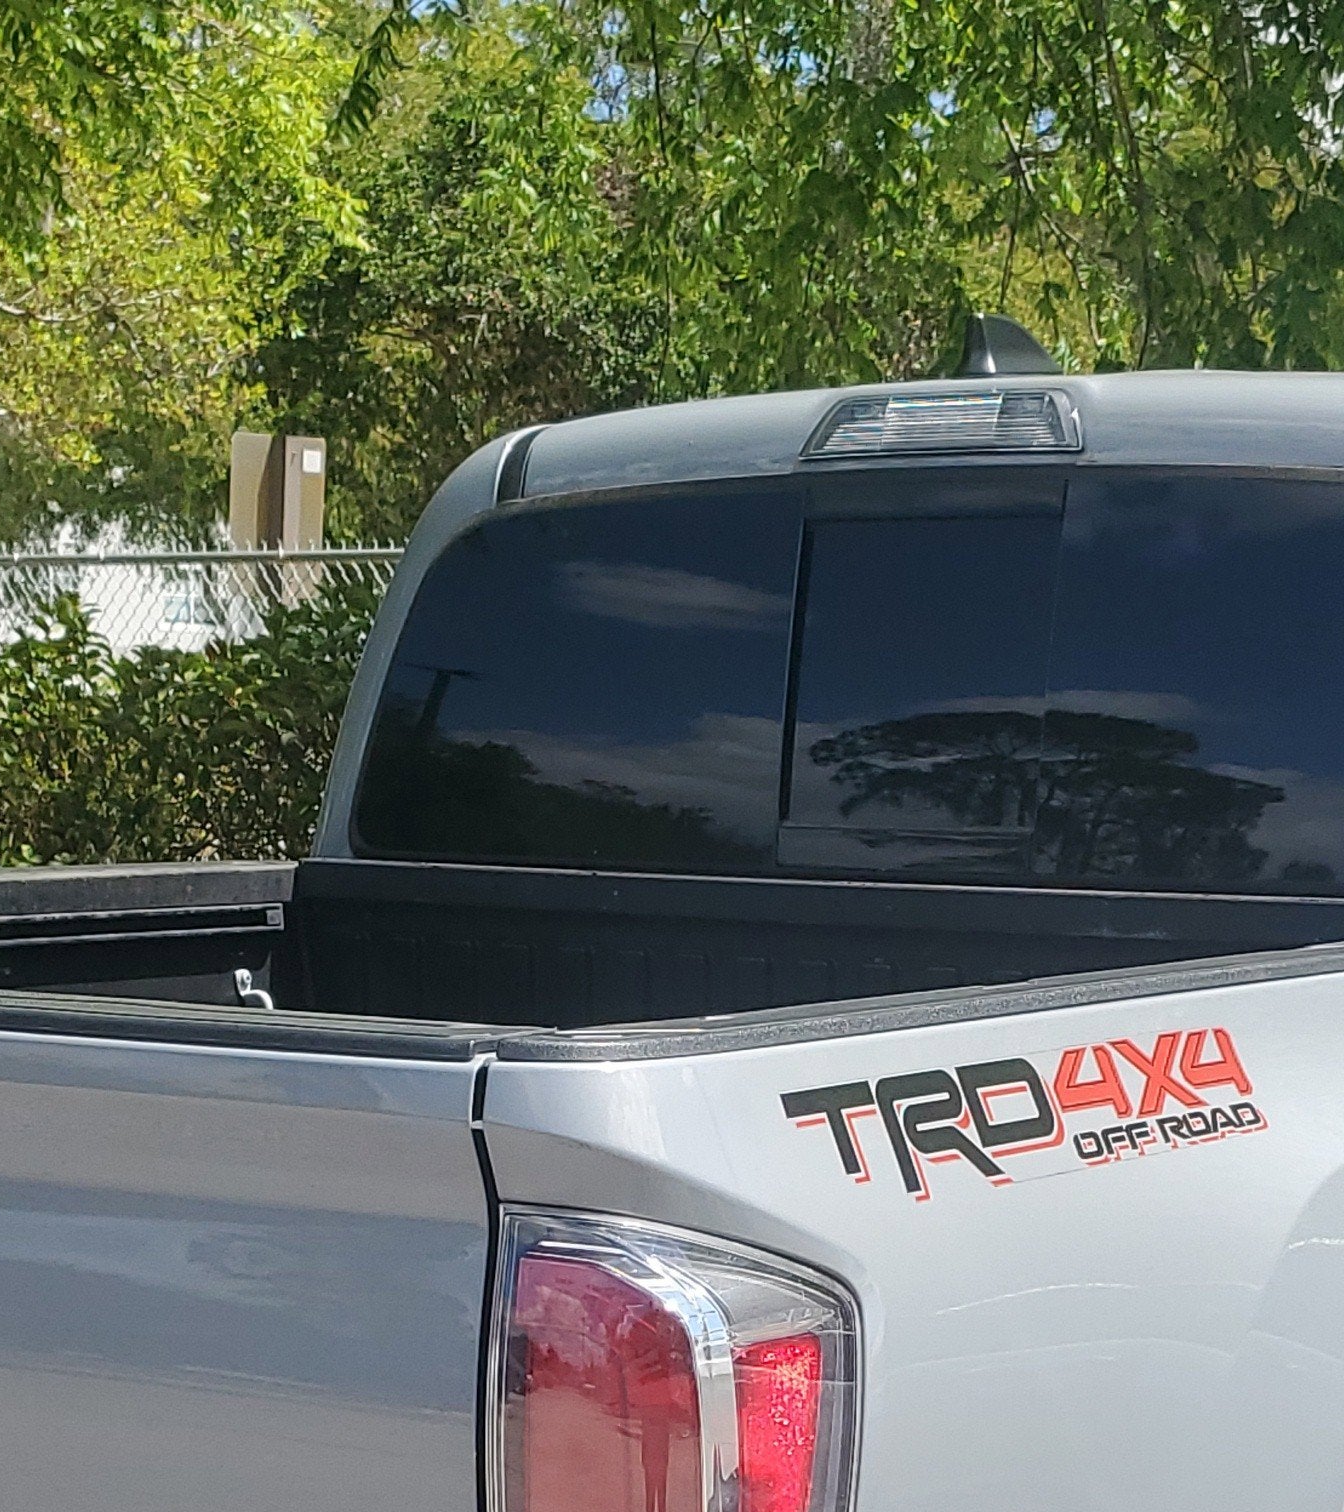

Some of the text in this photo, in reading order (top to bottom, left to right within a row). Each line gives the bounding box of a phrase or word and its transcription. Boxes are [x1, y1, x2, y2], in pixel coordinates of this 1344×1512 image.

[780, 1027, 1253, 1202] TRD 4X4
[1072, 1101, 1267, 1166] OFF ROAD
